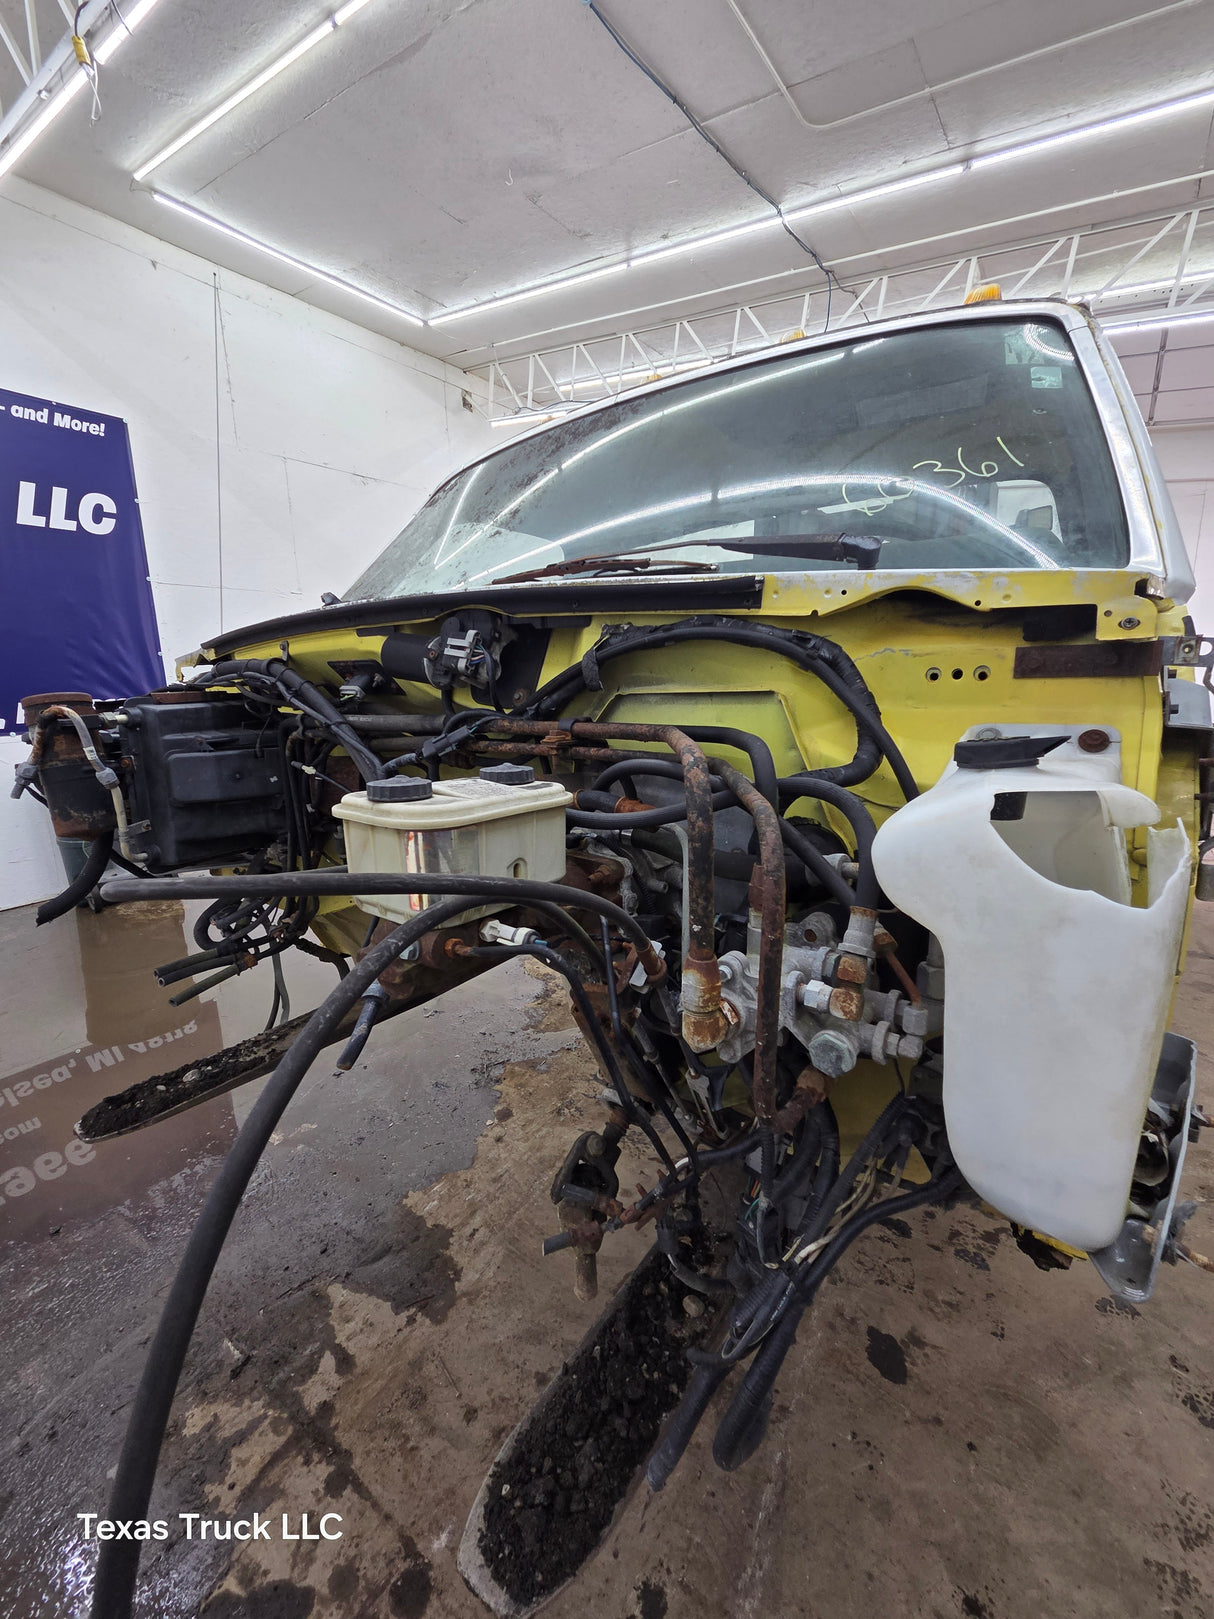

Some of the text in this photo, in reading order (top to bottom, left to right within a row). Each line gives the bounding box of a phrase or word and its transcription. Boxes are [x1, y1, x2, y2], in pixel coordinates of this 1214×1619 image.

[10, 405, 106, 437] and More!
[16, 480, 117, 535] LLC
